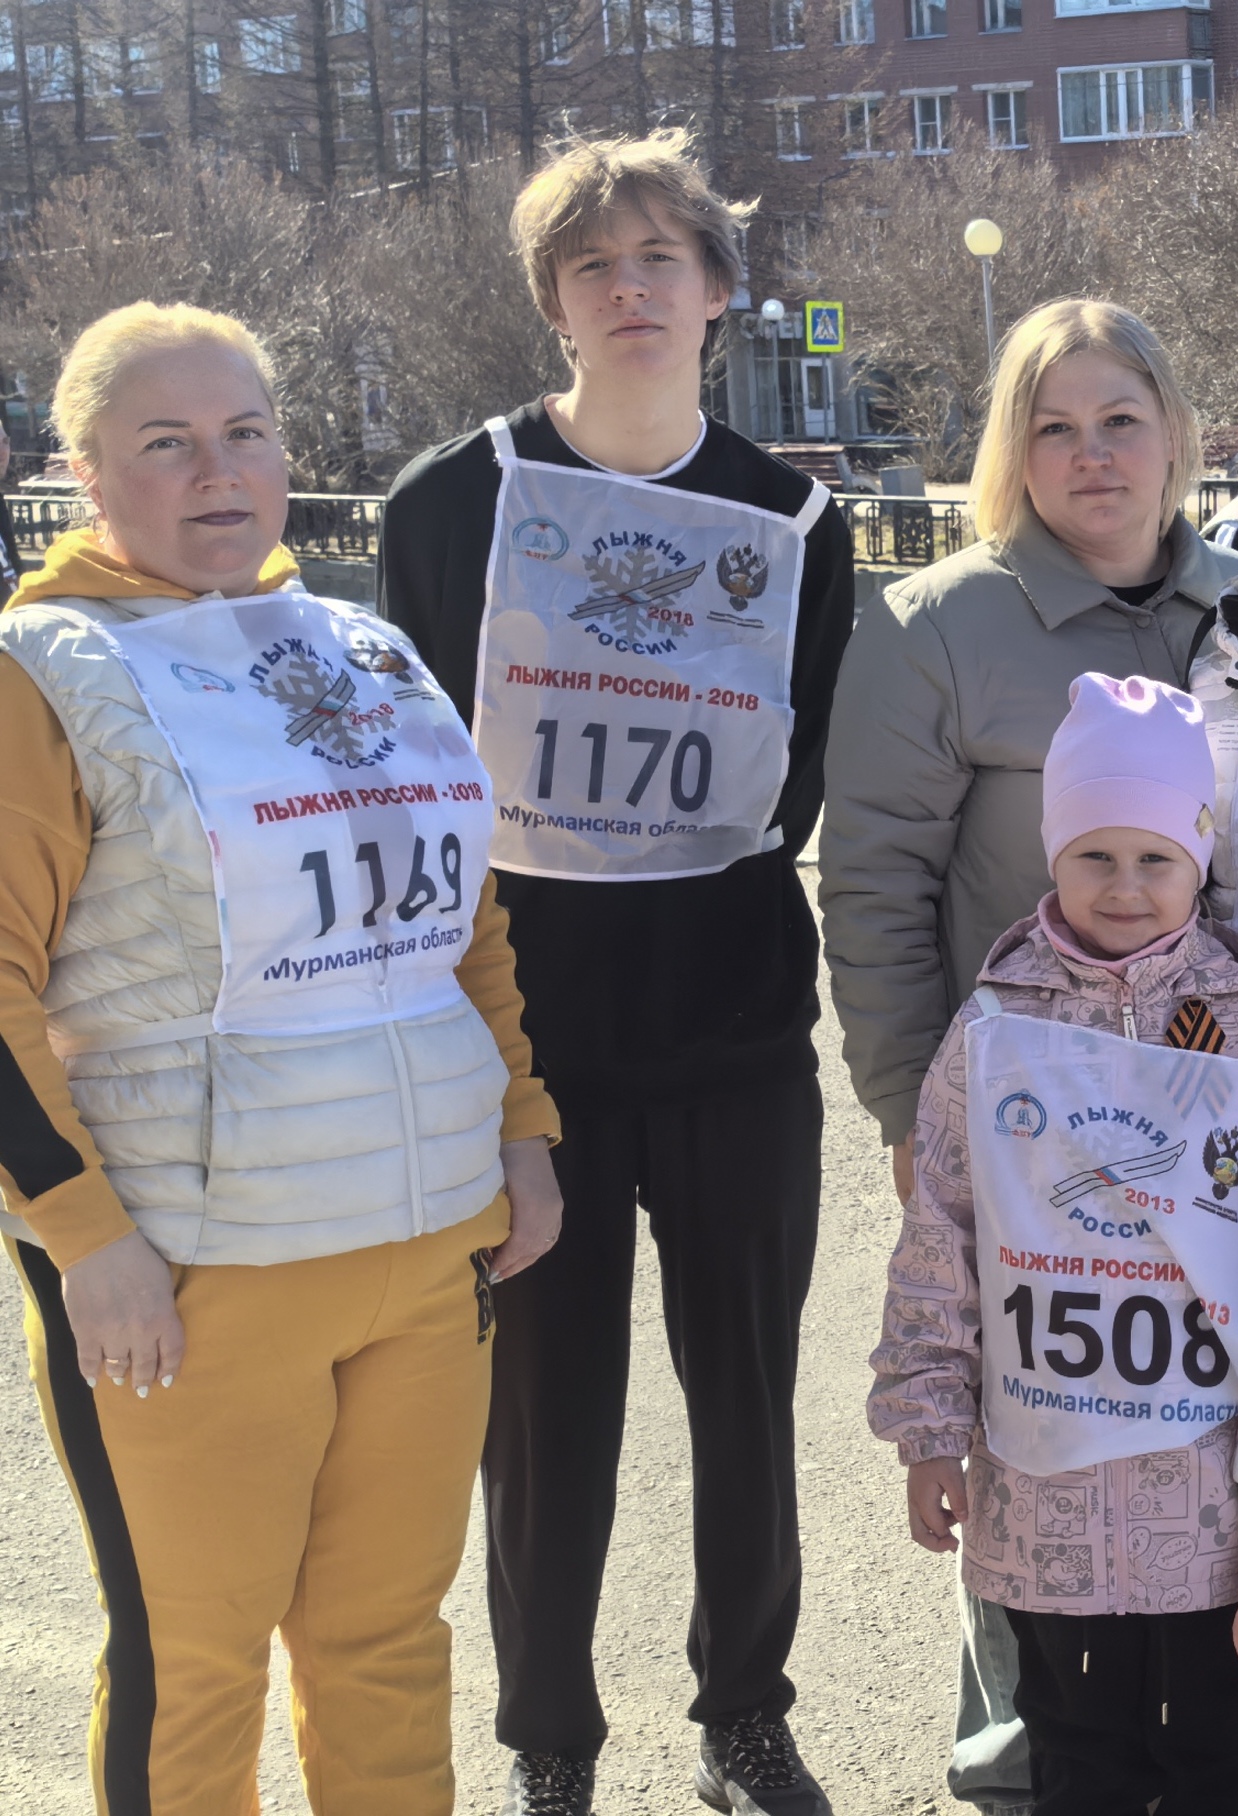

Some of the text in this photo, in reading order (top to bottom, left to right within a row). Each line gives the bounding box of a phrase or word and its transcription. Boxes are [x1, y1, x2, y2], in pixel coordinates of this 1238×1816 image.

[592, 530, 688, 567] ЛЫЖНЯ
[647, 606, 695, 627] 2018
[584, 623, 678, 655] РОССИИ
[506, 665, 591, 690] ЛЫЖНЯ
[599, 674, 689, 702] РОССИИ
[707, 688, 759, 711] 2018
[349, 703, 395, 727] 2018
[310, 736, 397, 770] РОССИИ
[535, 719, 712, 813] 1170
[253, 787, 358, 825] ЛЫЖНЯ
[361, 783, 437, 808] РОССИИ
[449, 782, 483, 801] 2018
[500, 806, 641, 837] Мурманская
[300, 831, 463, 939] 1169
[263, 934, 416, 982] Мурманская
[1067, 1106, 1169, 1147] ЛЫЖНЯ
[1124, 1187, 1176, 1215] 2013
[1068, 1206, 1153, 1239] РОССИ
[1000, 1245, 1231, 1326] ЛЫЖНЯ РОССИИ 13
[1003, 1284, 1230, 1388] 1508
[1002, 1374, 1152, 1421] Мурманская
